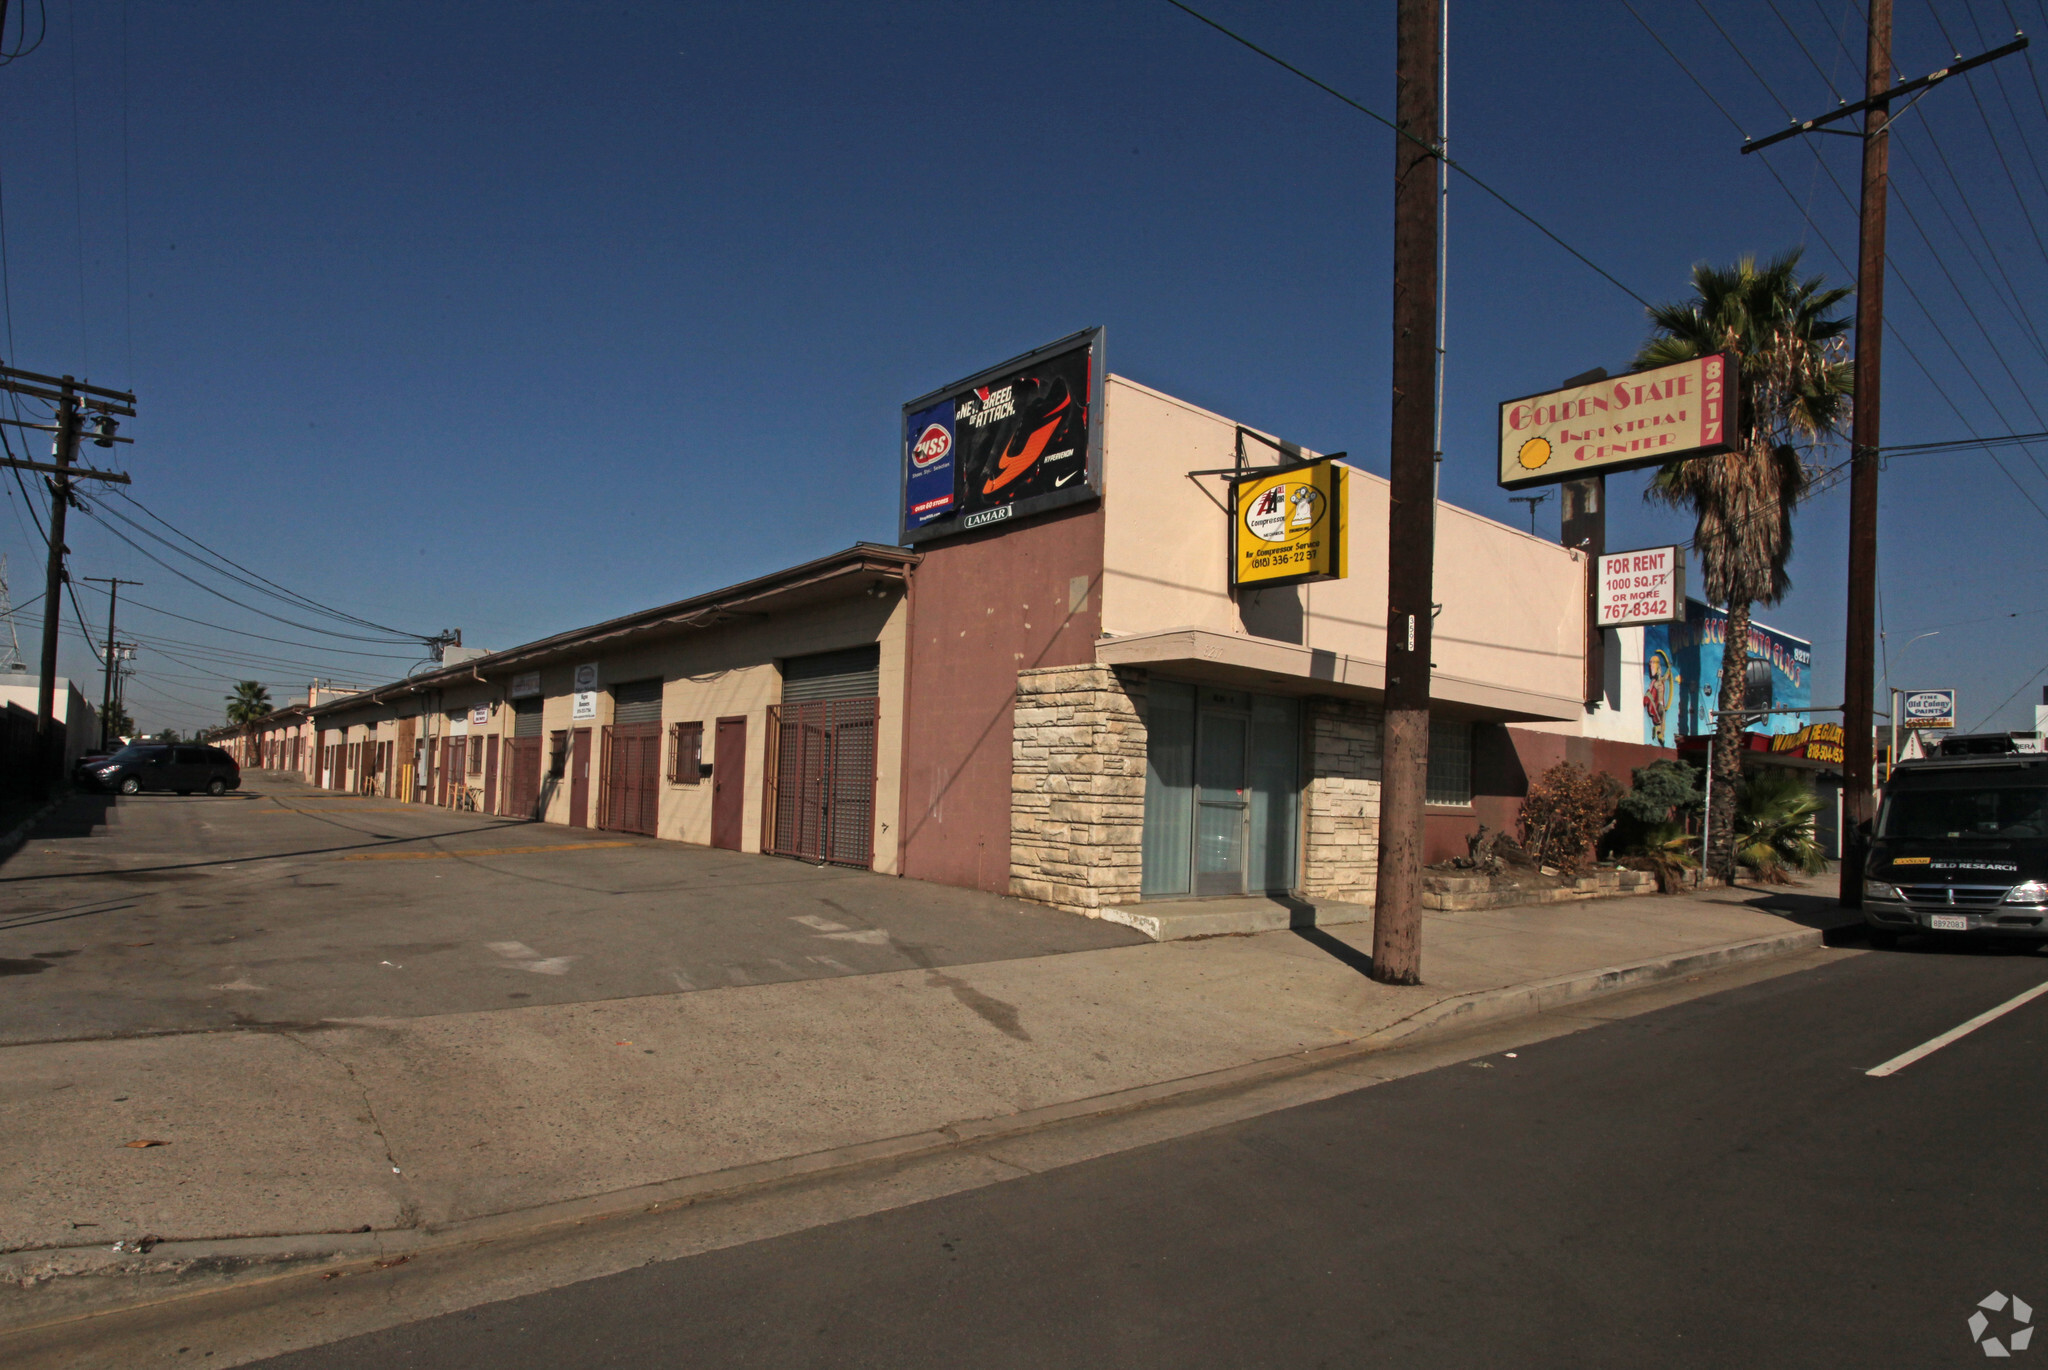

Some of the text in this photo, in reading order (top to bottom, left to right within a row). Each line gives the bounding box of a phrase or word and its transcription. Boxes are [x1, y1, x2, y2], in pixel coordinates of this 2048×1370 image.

[1509, 374, 1694, 431] GOLDEN STATE
[1705, 361, 1722, 441] 8217
[1574, 432, 1676, 461] CENTER
[968, 508, 1005, 526] LAMAR
[1252, 558, 1270, 568] (818)
[1607, 553, 1666, 575] FOR RENT
[1606, 577, 1631, 591] 1000
[1612, 590, 1660, 602] OR MORE
[1604, 600, 1667, 619] 767-8342
[1793, 648, 1810, 664] 8217
[1959, 863, 2018, 871] RESEARCH
